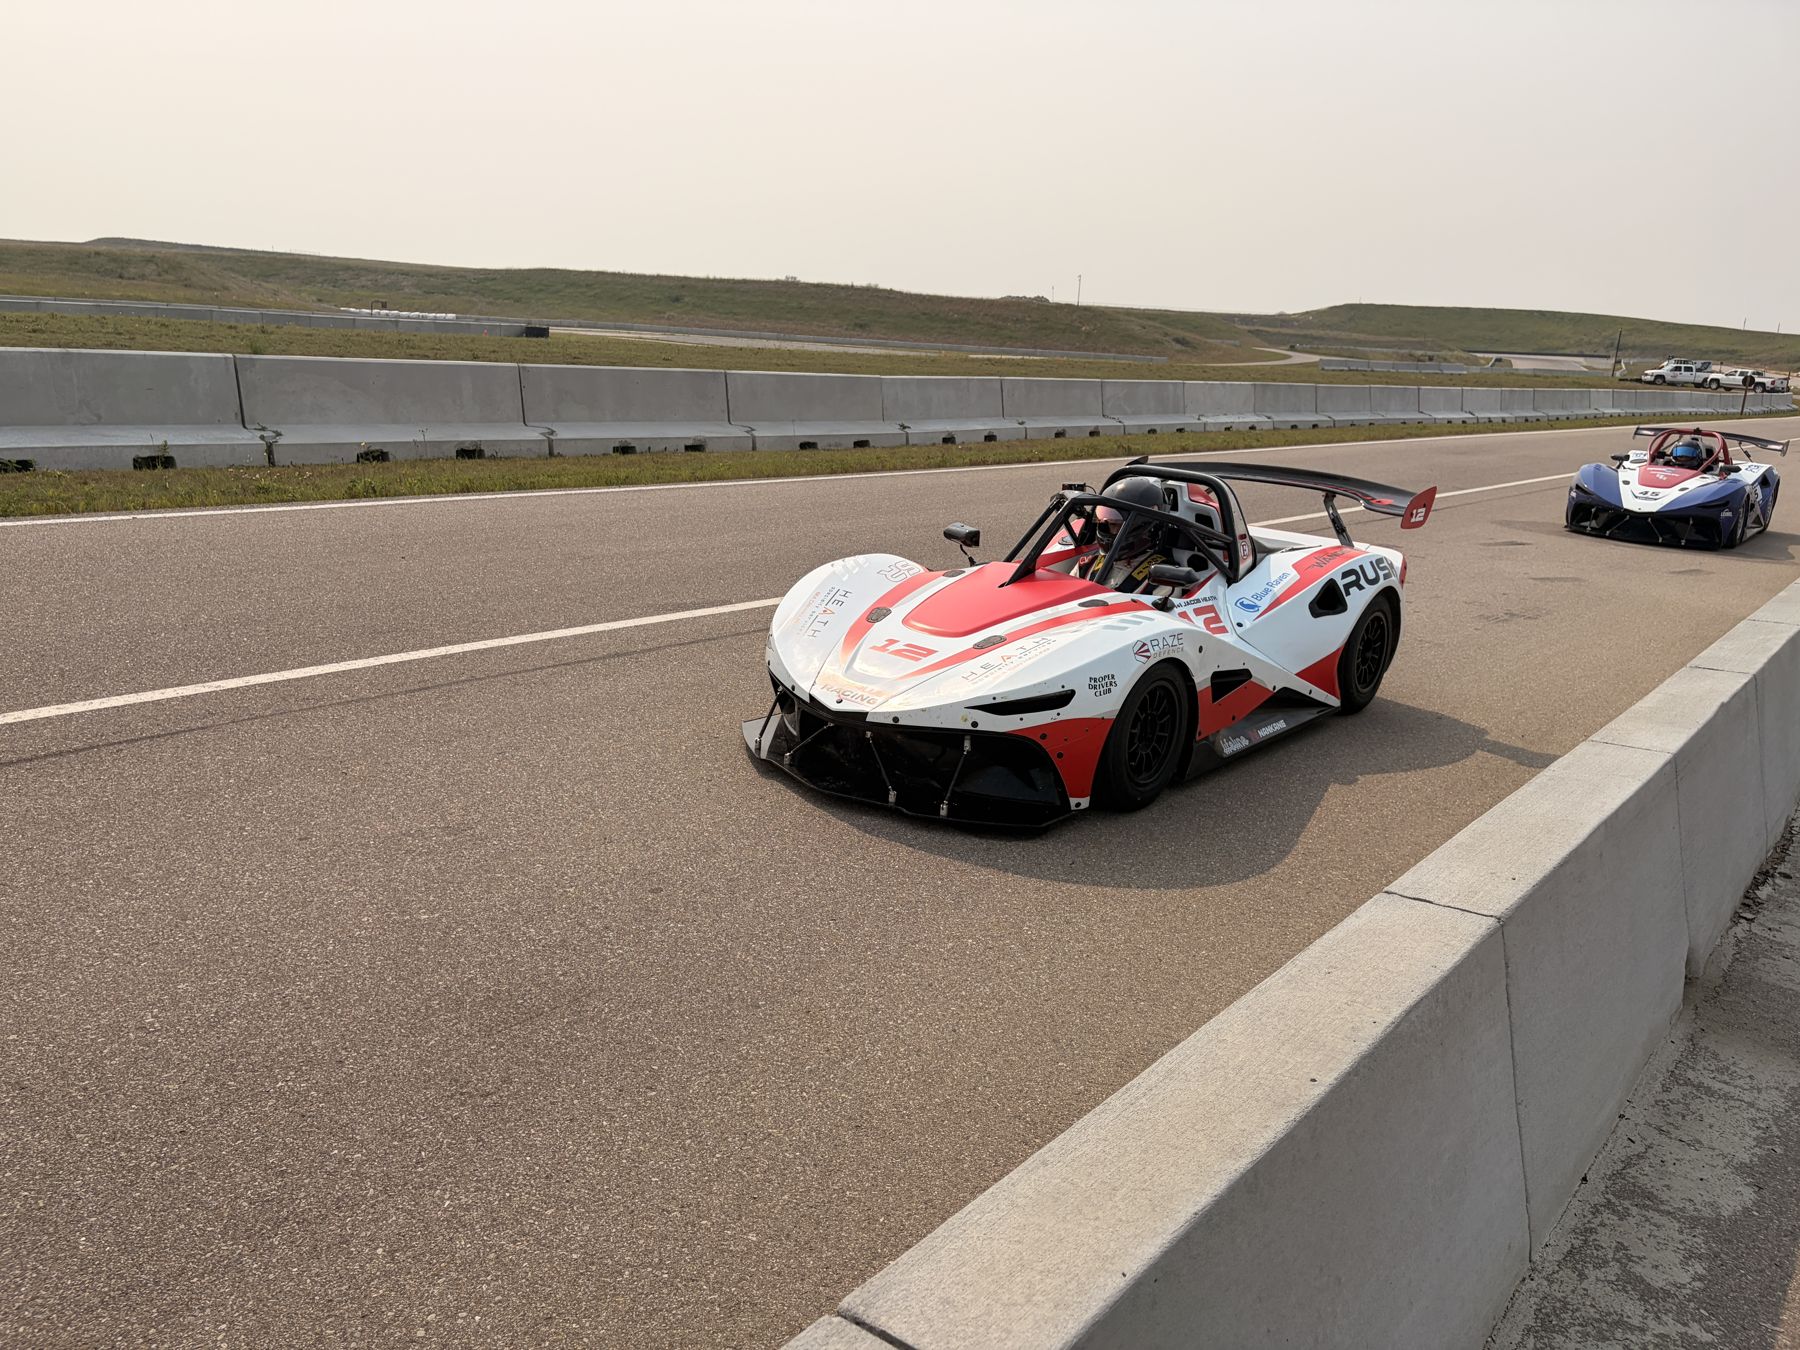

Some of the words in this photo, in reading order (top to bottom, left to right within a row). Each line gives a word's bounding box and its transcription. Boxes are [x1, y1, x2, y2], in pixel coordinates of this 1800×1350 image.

[1410, 507, 1426, 523] 12
[1251, 586, 1273, 602] Blue
[1266, 571, 1291, 588] Raven
[808, 589, 853, 637] HEATH
[1177, 604, 1230, 635] 12
[869, 638, 939, 662] 12
[1150, 632, 1184, 651] RAZE
[1088, 680, 1118, 690] DRIVERS
[1089, 673, 1116, 684] PROPER
[820, 684, 879, 705] RACING
[1094, 688, 1112, 697] CLUB
